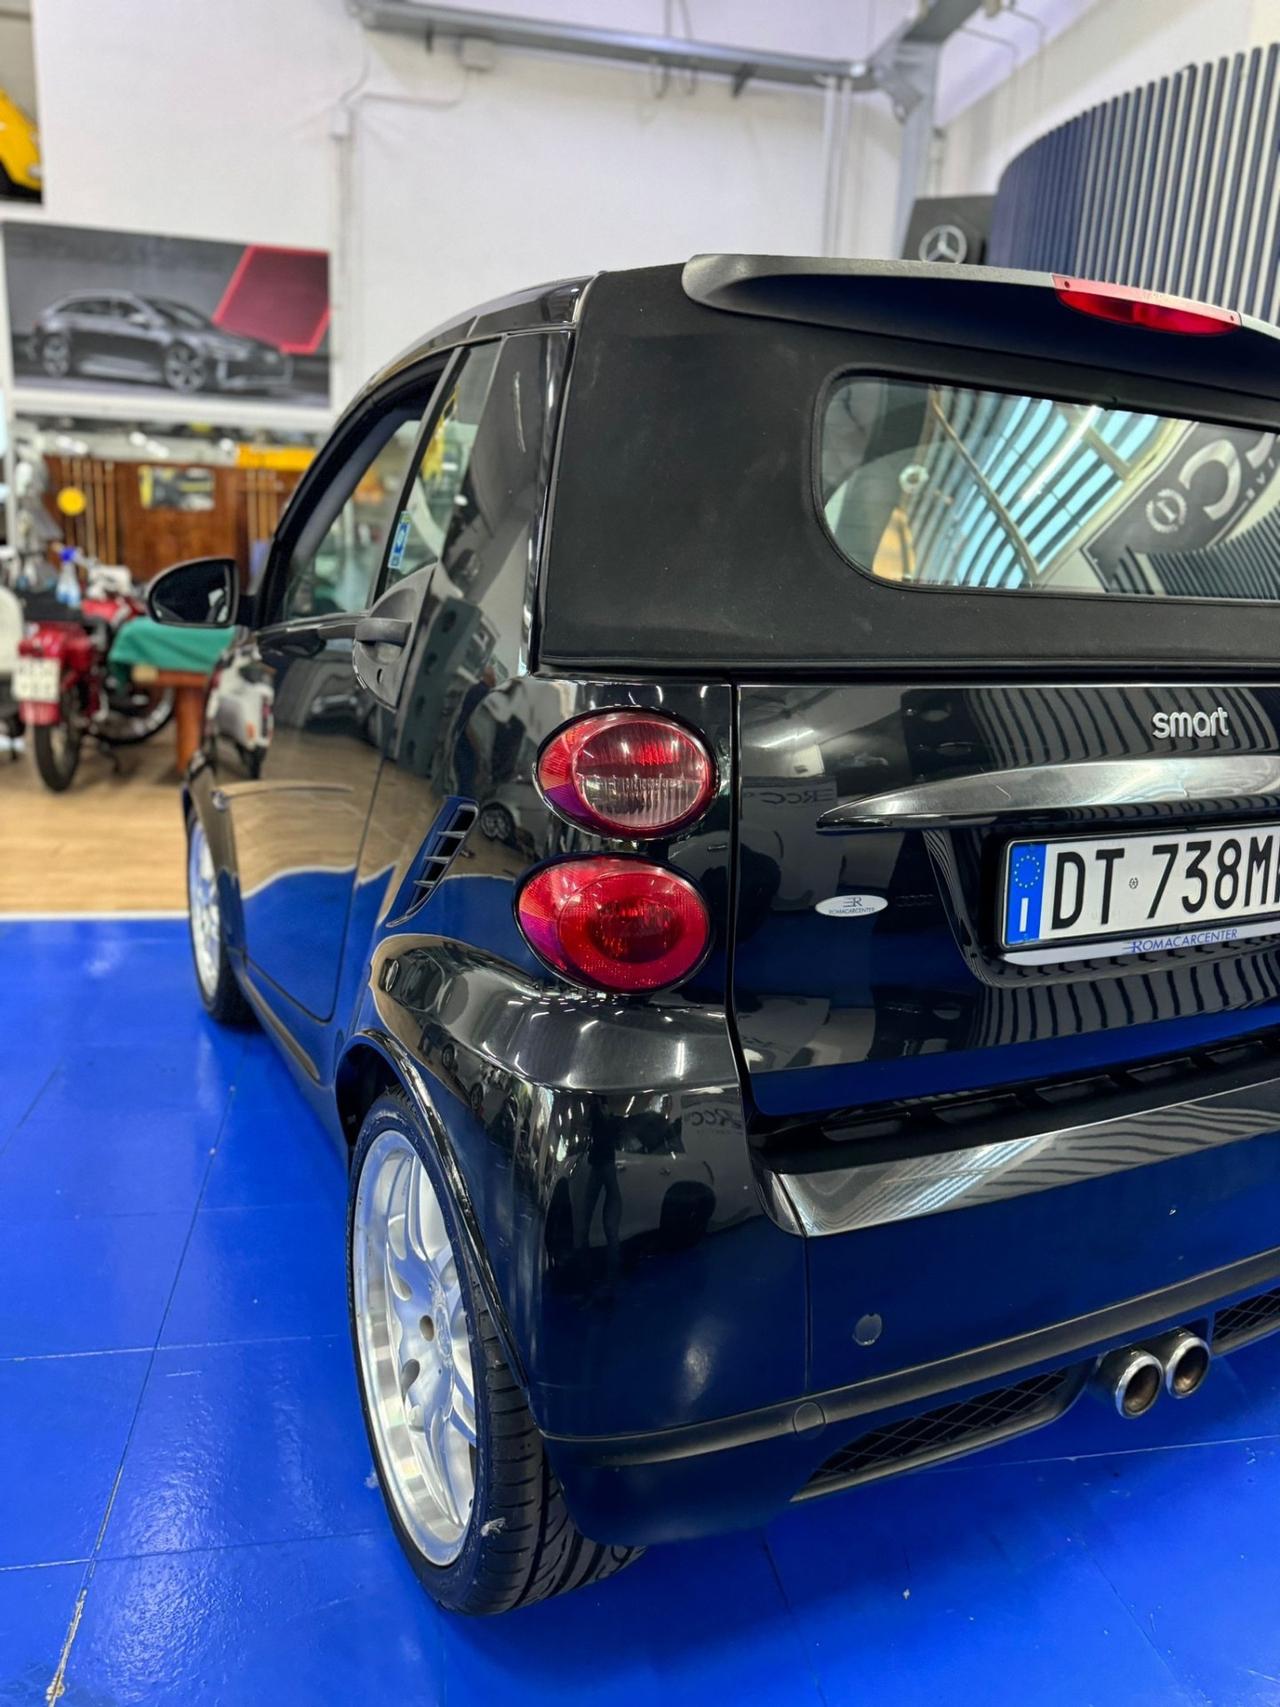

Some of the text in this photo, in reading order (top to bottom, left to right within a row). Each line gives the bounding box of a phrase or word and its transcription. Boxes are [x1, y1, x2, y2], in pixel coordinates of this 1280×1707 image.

[1152, 707, 1230, 739] smart
[1018, 834, 1280, 933] I DT 738M
[1127, 929, 1238, 953] ROMACARCENTER
